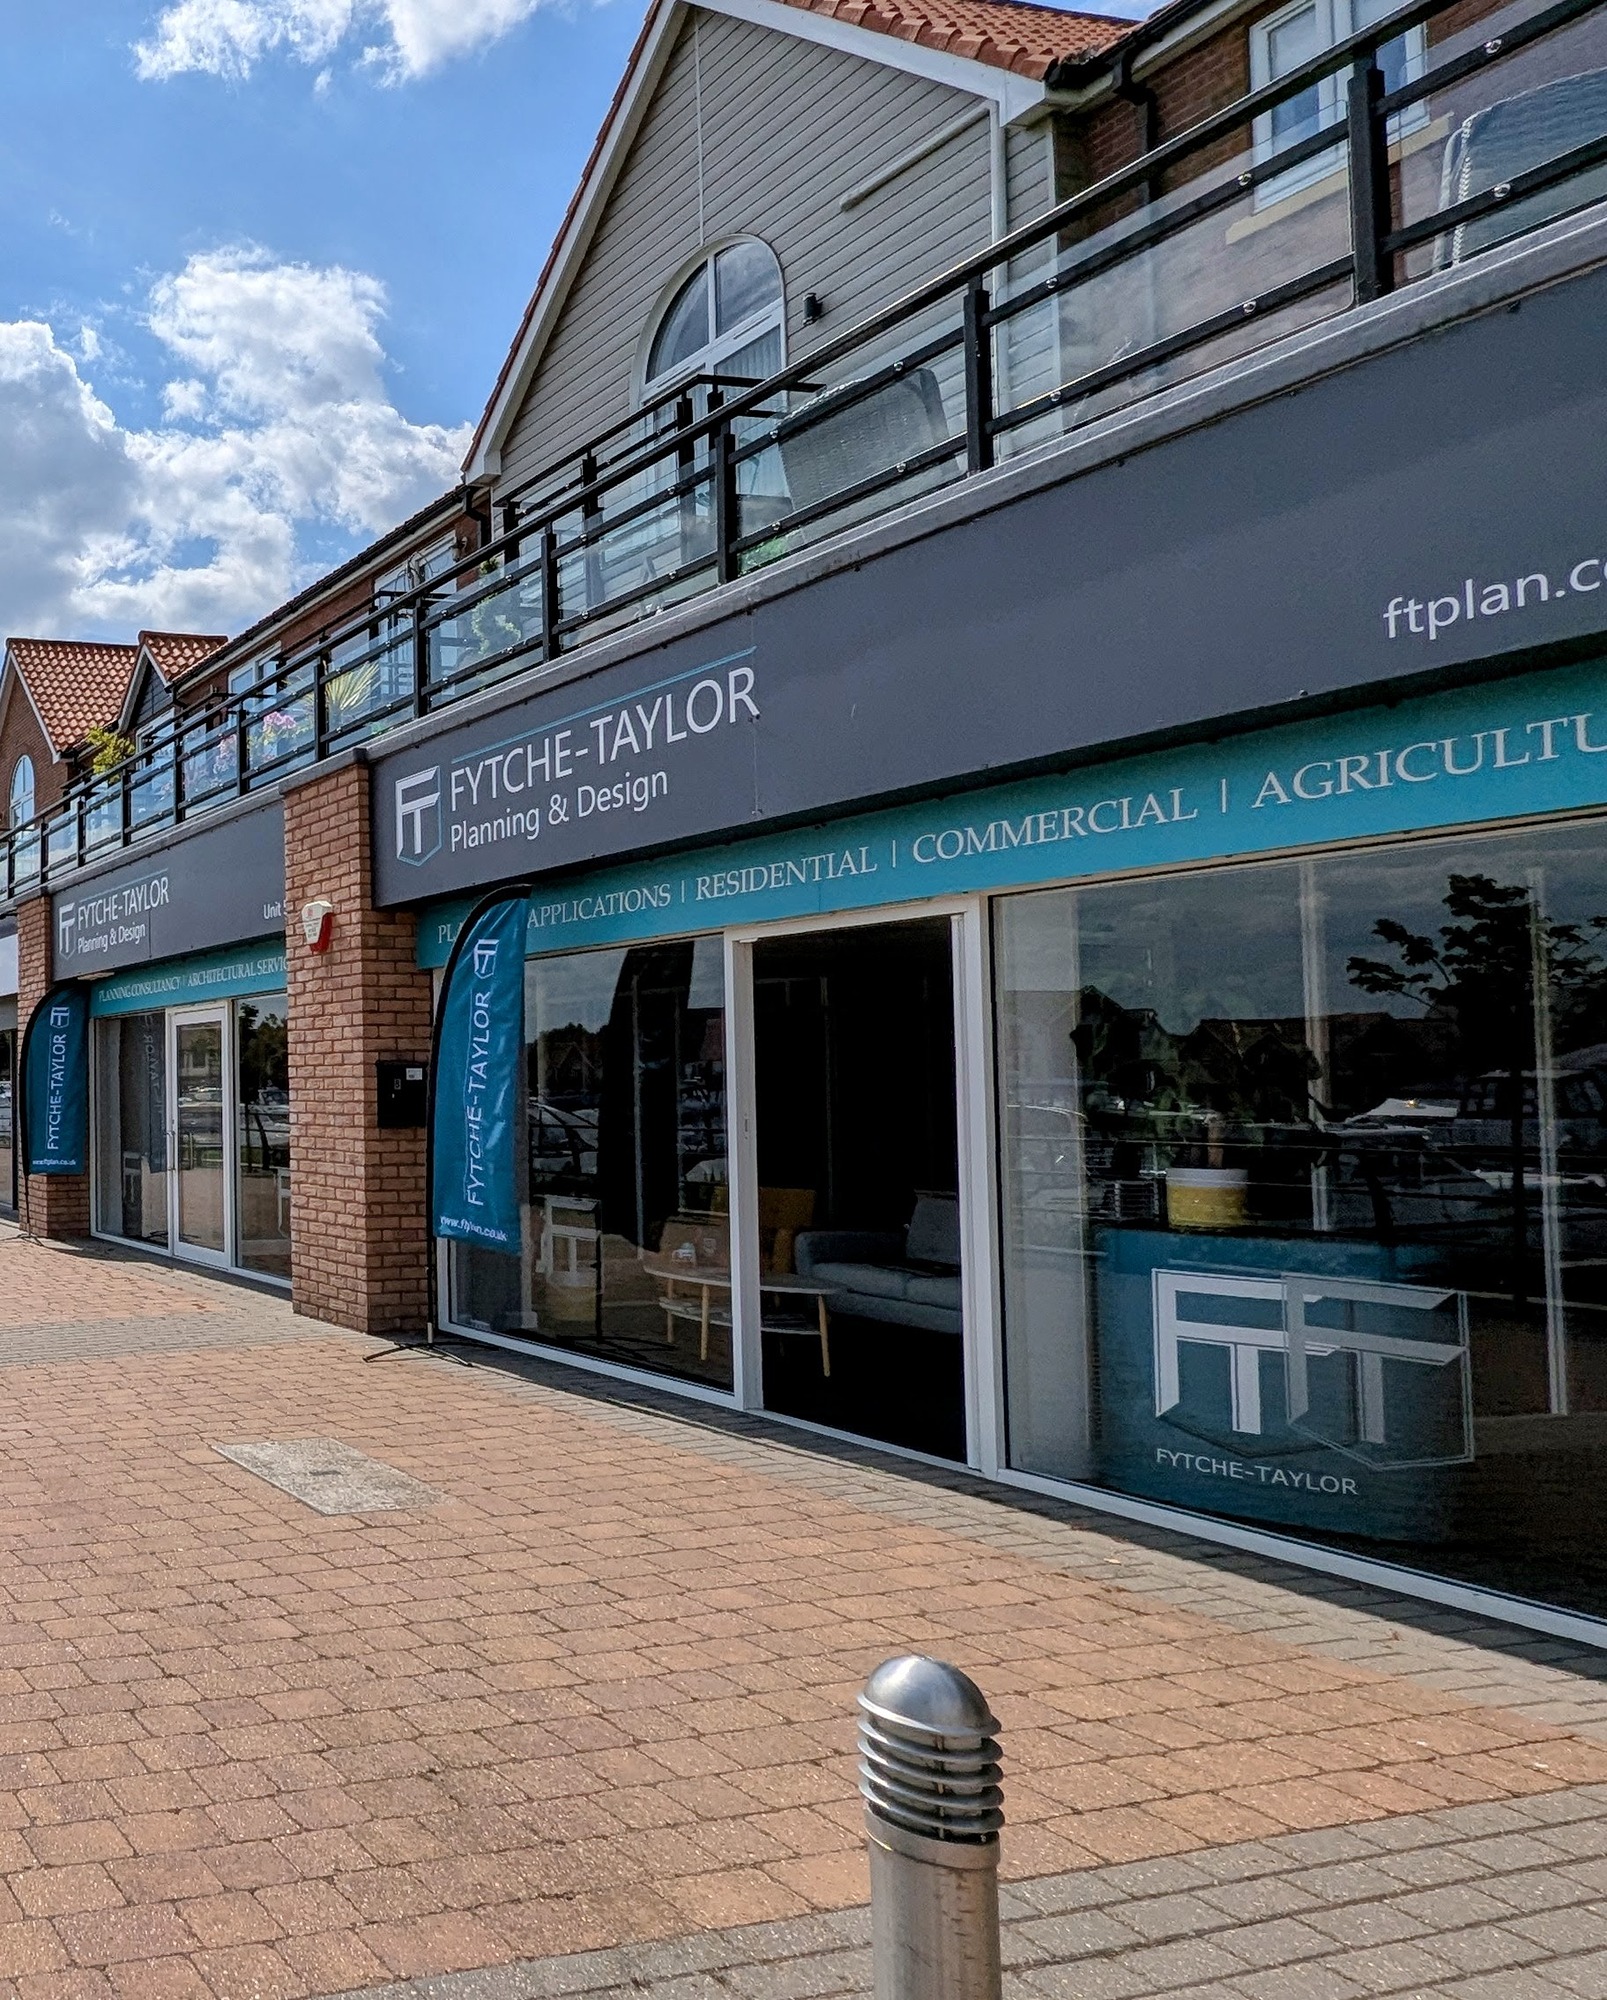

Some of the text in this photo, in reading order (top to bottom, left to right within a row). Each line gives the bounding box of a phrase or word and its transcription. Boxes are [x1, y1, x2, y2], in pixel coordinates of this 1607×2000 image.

[1383, 558, 1607, 640] ftplan.c
[451, 666, 760, 811] FYTCHE-TAYLOR
[451, 769, 668, 853] Planning & Design
[527, 884, 671, 928] APPLICATIONS
[695, 846, 877, 900] RESIDENTIAL
[913, 788, 1198, 863] COMMERCIAL
[78, 877, 169, 931] FYTCHE-TAYLOR
[78, 922, 146, 955] Planning & Design
[263, 901, 281, 919] Unit
[187, 962, 256, 987] ARCHITECTURAL
[47, 1034, 67, 1150] FYTCHE-TAYLOR
[467, 991, 491, 1206] FYTCHE-TAYLOR
[1156, 1448, 1359, 1496] FYTCHE-TAYLOR
